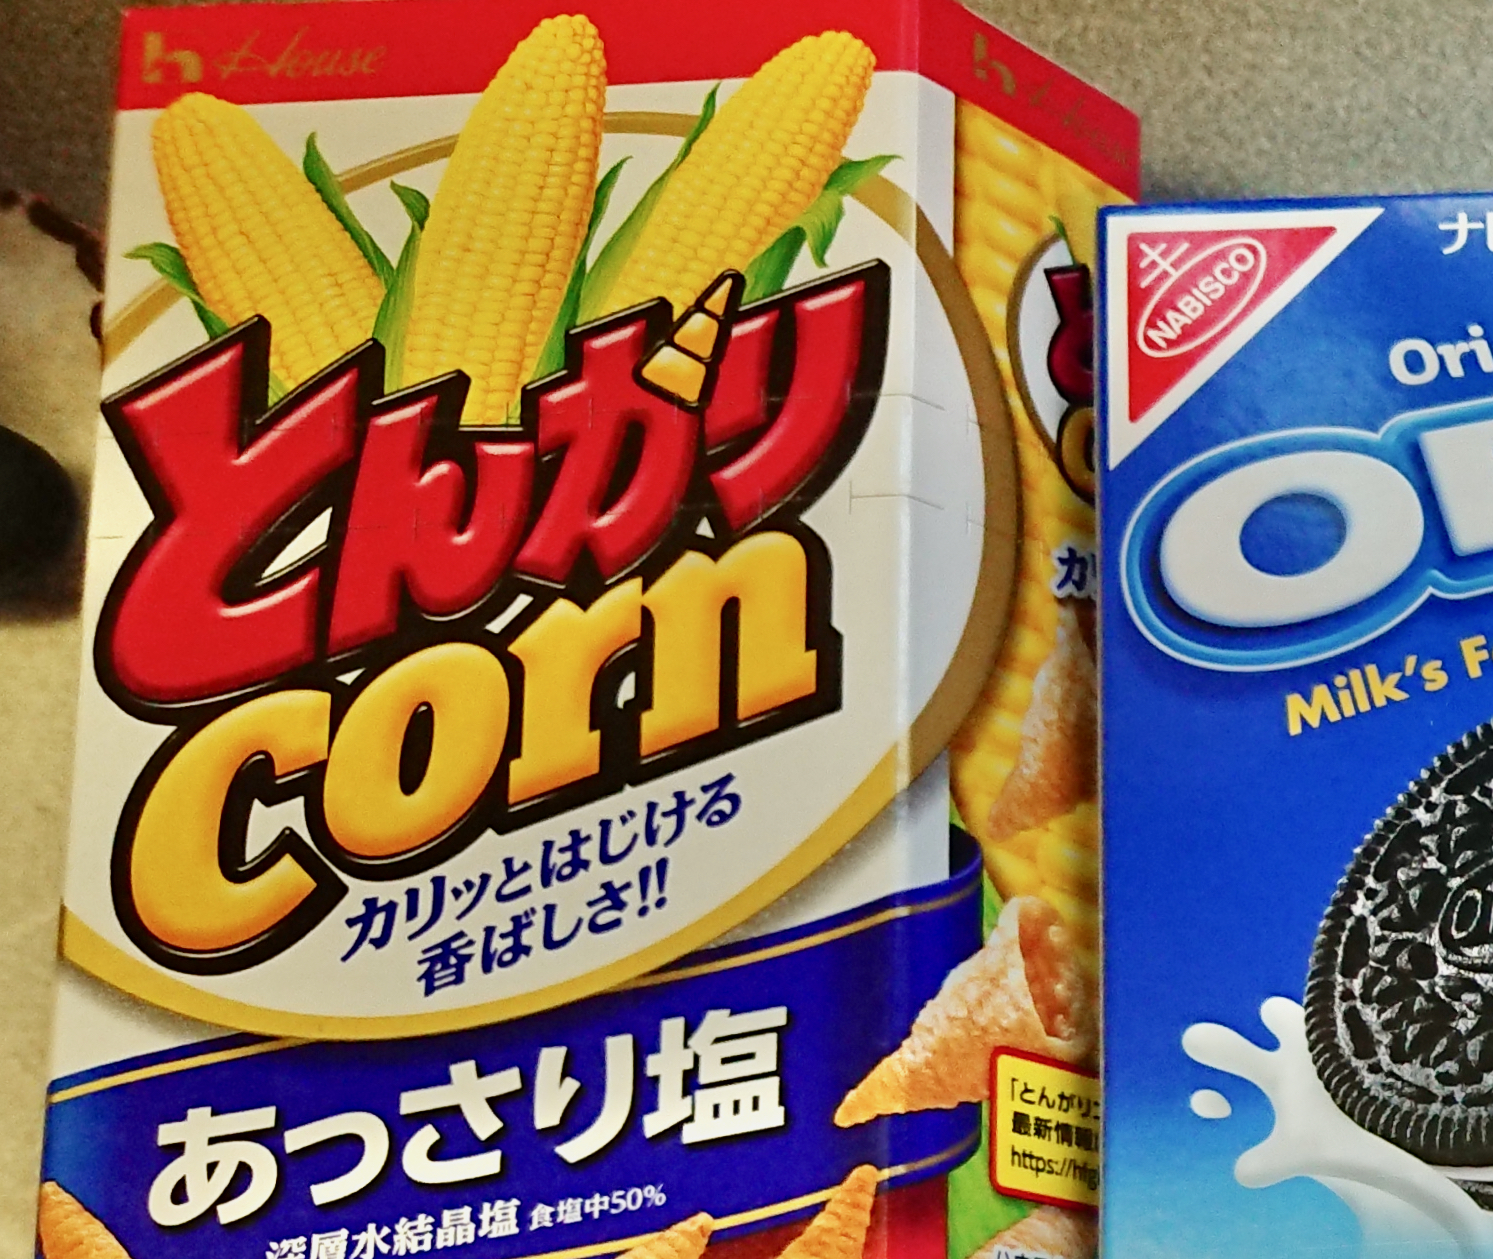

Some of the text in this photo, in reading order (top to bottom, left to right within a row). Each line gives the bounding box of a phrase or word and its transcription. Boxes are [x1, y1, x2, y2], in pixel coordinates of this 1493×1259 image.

[213, 26, 388, 80] House
[1146, 244, 1257, 351] NABISCO
[94, 259, 890, 728] とんがり
[110, 520, 842, 975] corn
[340, 773, 743, 963] カリッとはじける
[416, 858, 669, 997] 香ばしさ!!
[148, 1006, 788, 1228] あっさり塩
[529, 1185, 667, 1231] 食塩中50%
